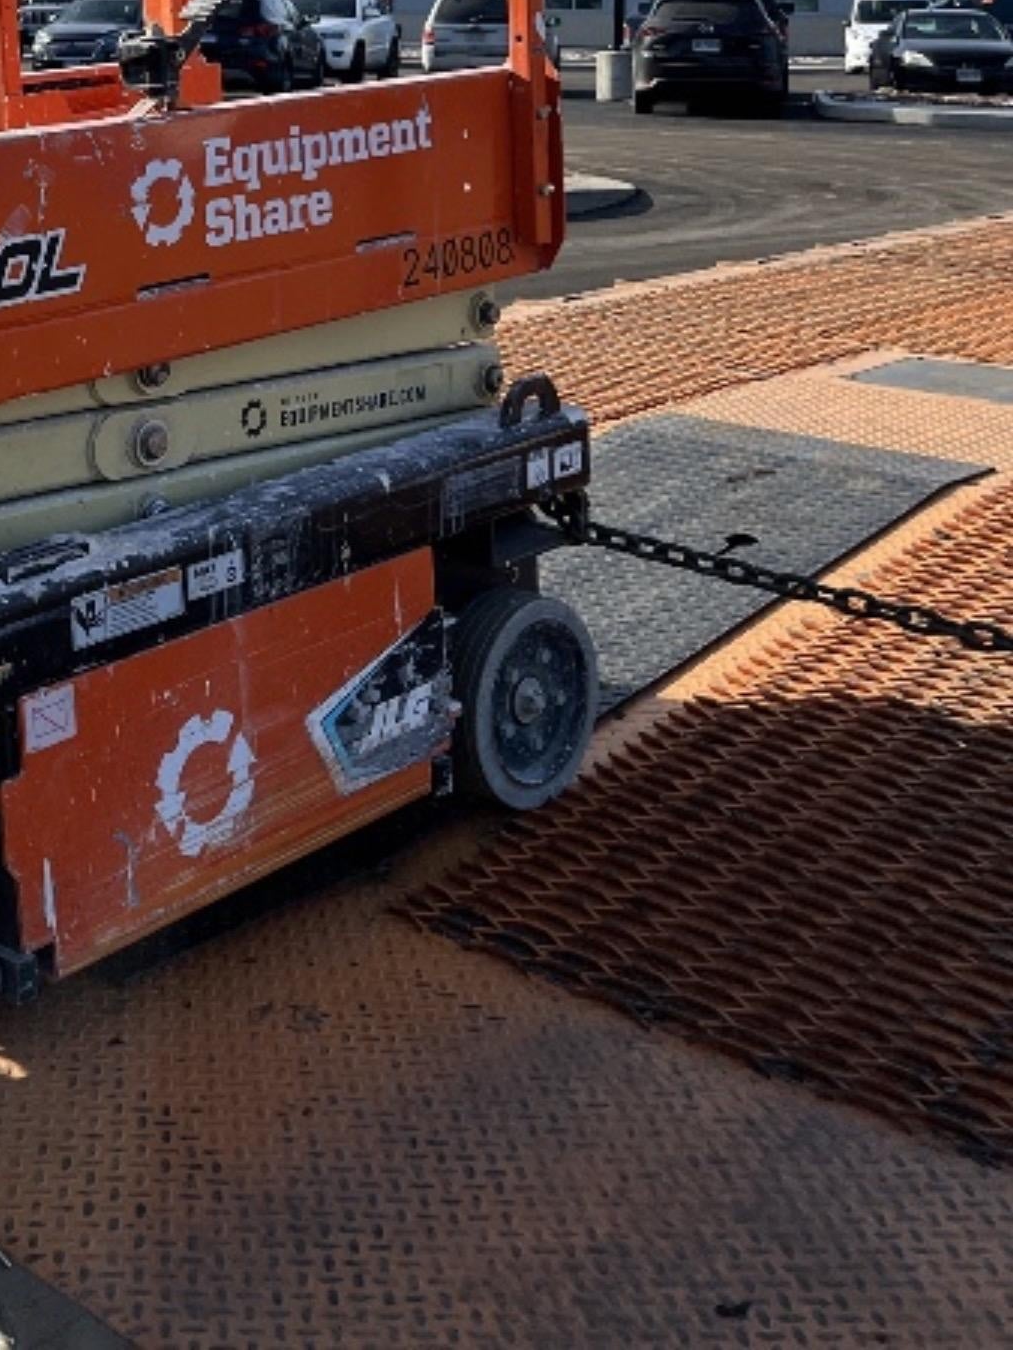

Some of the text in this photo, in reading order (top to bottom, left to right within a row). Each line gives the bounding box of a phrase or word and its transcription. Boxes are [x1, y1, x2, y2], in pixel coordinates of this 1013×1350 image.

[202, 105, 433, 191] Equipment
[204, 188, 334, 247] Share
[402, 227, 514, 288] 240808
[354, 681, 433, 755] JLG
